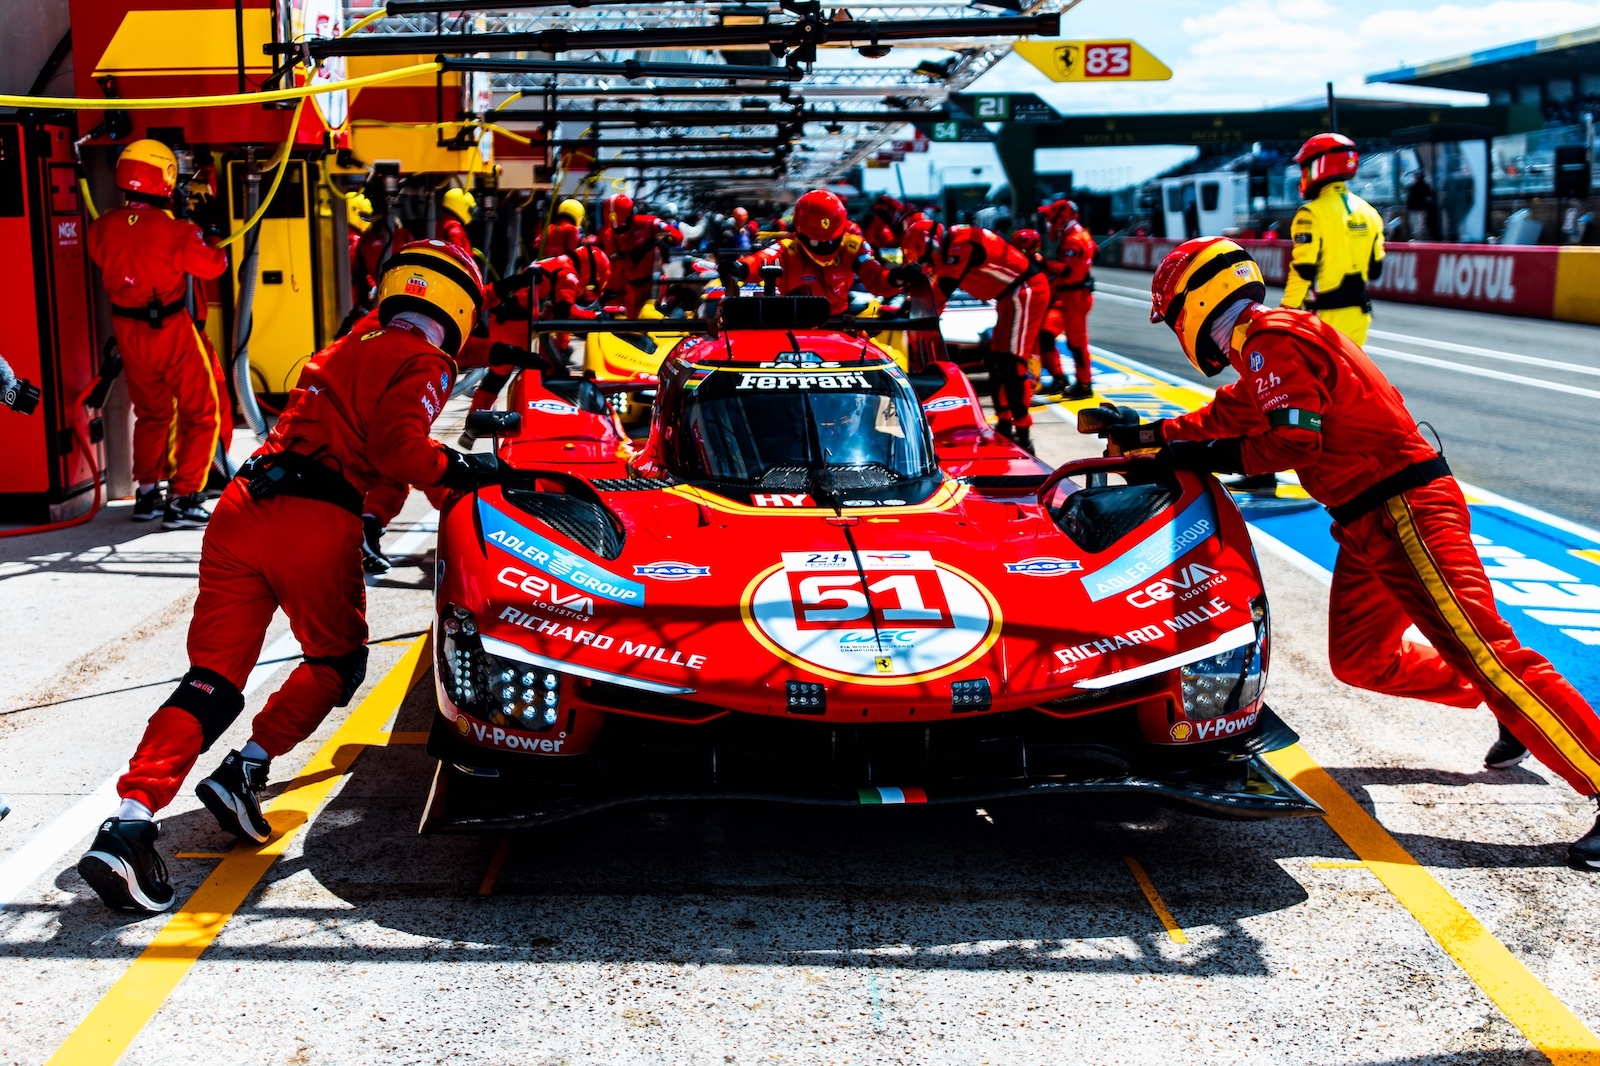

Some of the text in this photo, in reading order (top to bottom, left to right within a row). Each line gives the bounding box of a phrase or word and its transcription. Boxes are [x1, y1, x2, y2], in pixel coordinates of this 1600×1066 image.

[1086, 47, 1129, 73] 83
[978, 97, 1004, 115] 21
[934, 122, 957, 139] 54
[58, 222, 77, 238] NGK
[1433, 253, 1516, 302] MOTUL
[1250, 353, 1261, 372] hp
[735, 371, 873, 389] Ferrari
[754, 494, 807, 506] HY
[488, 529, 638, 600] ADLER GROUP
[1096, 518, 1210, 594] ADLER GROUP
[798, 574, 943, 622] 51
[1179, 574, 1228, 601] LOGISTICS
[532, 600, 590, 623] LOGISTICS
[499, 605, 707, 670] RICHARD MILLE
[839, 630, 917, 643] WEC
[1053, 596, 1231, 665] RICHARD MILLE
[472, 722, 564, 753] V-Power
[1196, 711, 1259, 740] V-Power
